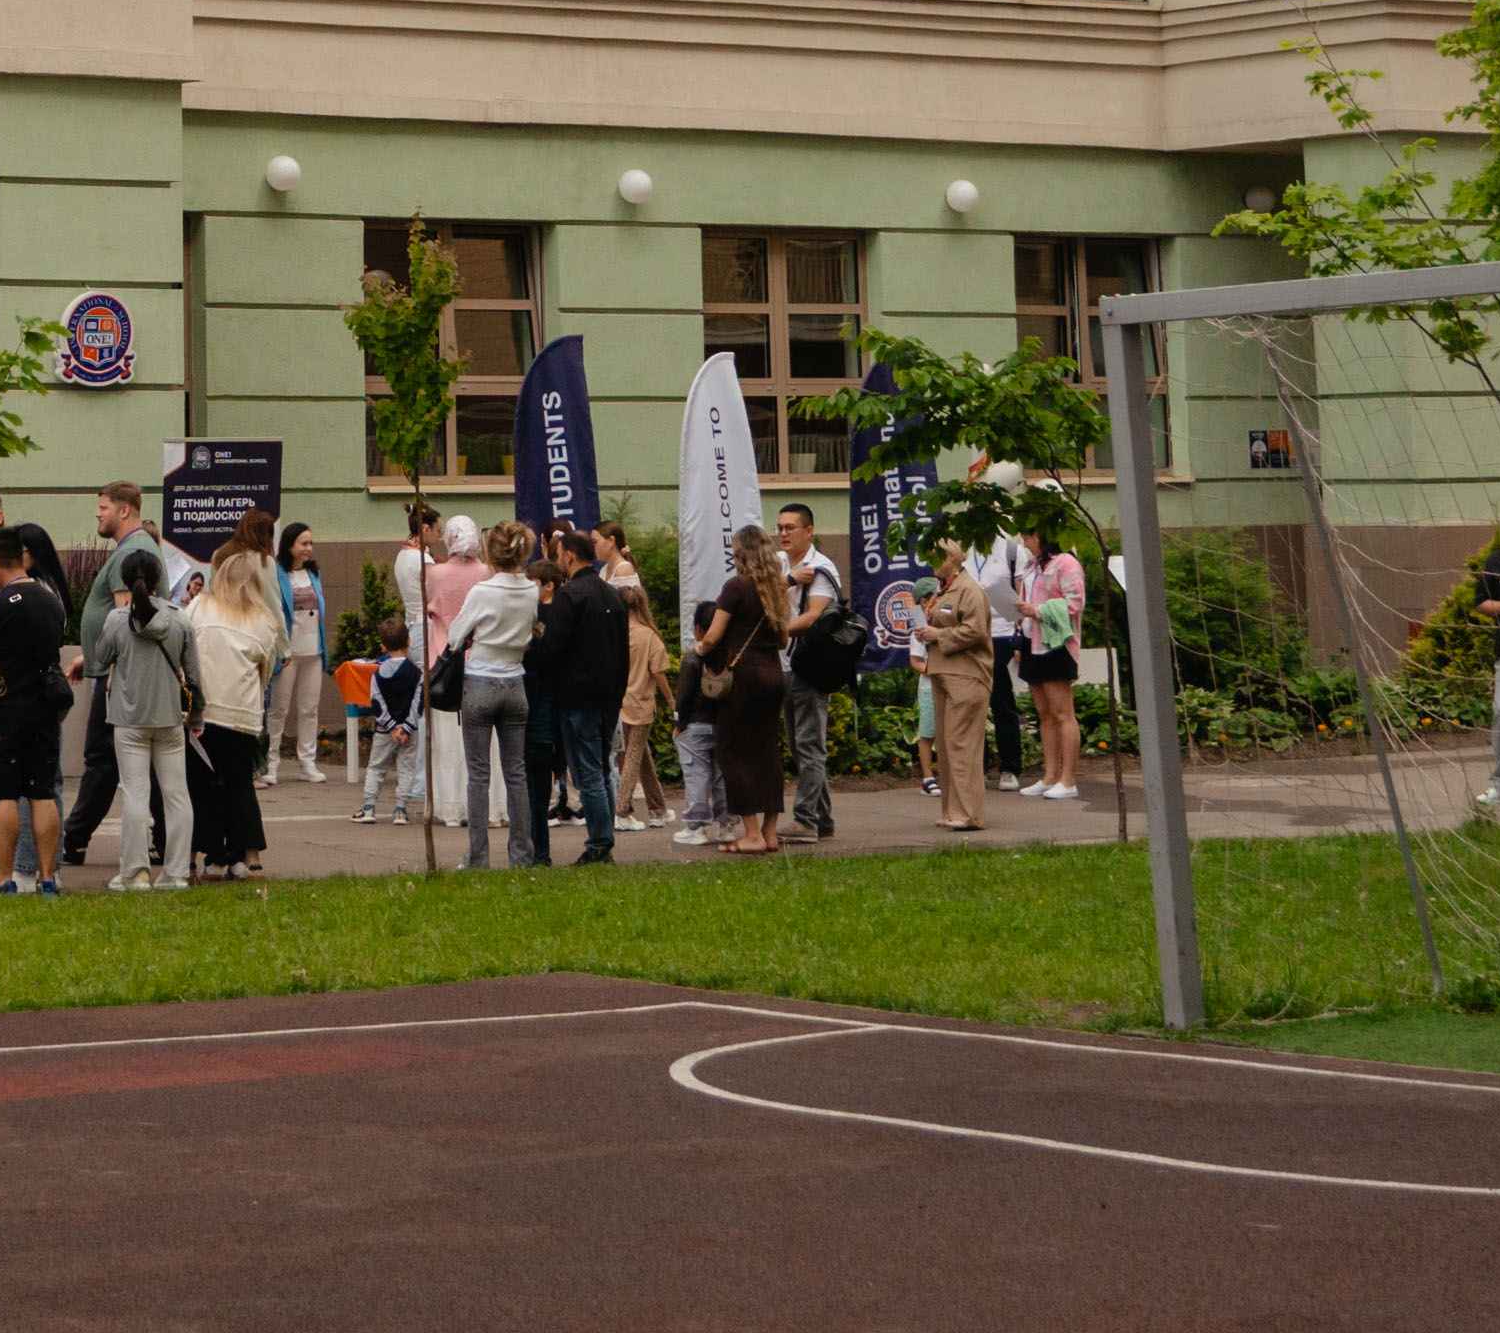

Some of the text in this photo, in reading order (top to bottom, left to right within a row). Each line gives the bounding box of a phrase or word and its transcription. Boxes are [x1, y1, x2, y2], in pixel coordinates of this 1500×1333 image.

[542, 390, 576, 530] TUDENTS
[709, 406, 737, 573] WELCOME TO
[173, 496, 256, 508] ЛЕТНИЙ ЛАГЕРЬ
[173, 511, 247, 522] В ПОДМОСКО
[860, 503, 883, 574] ONE!
